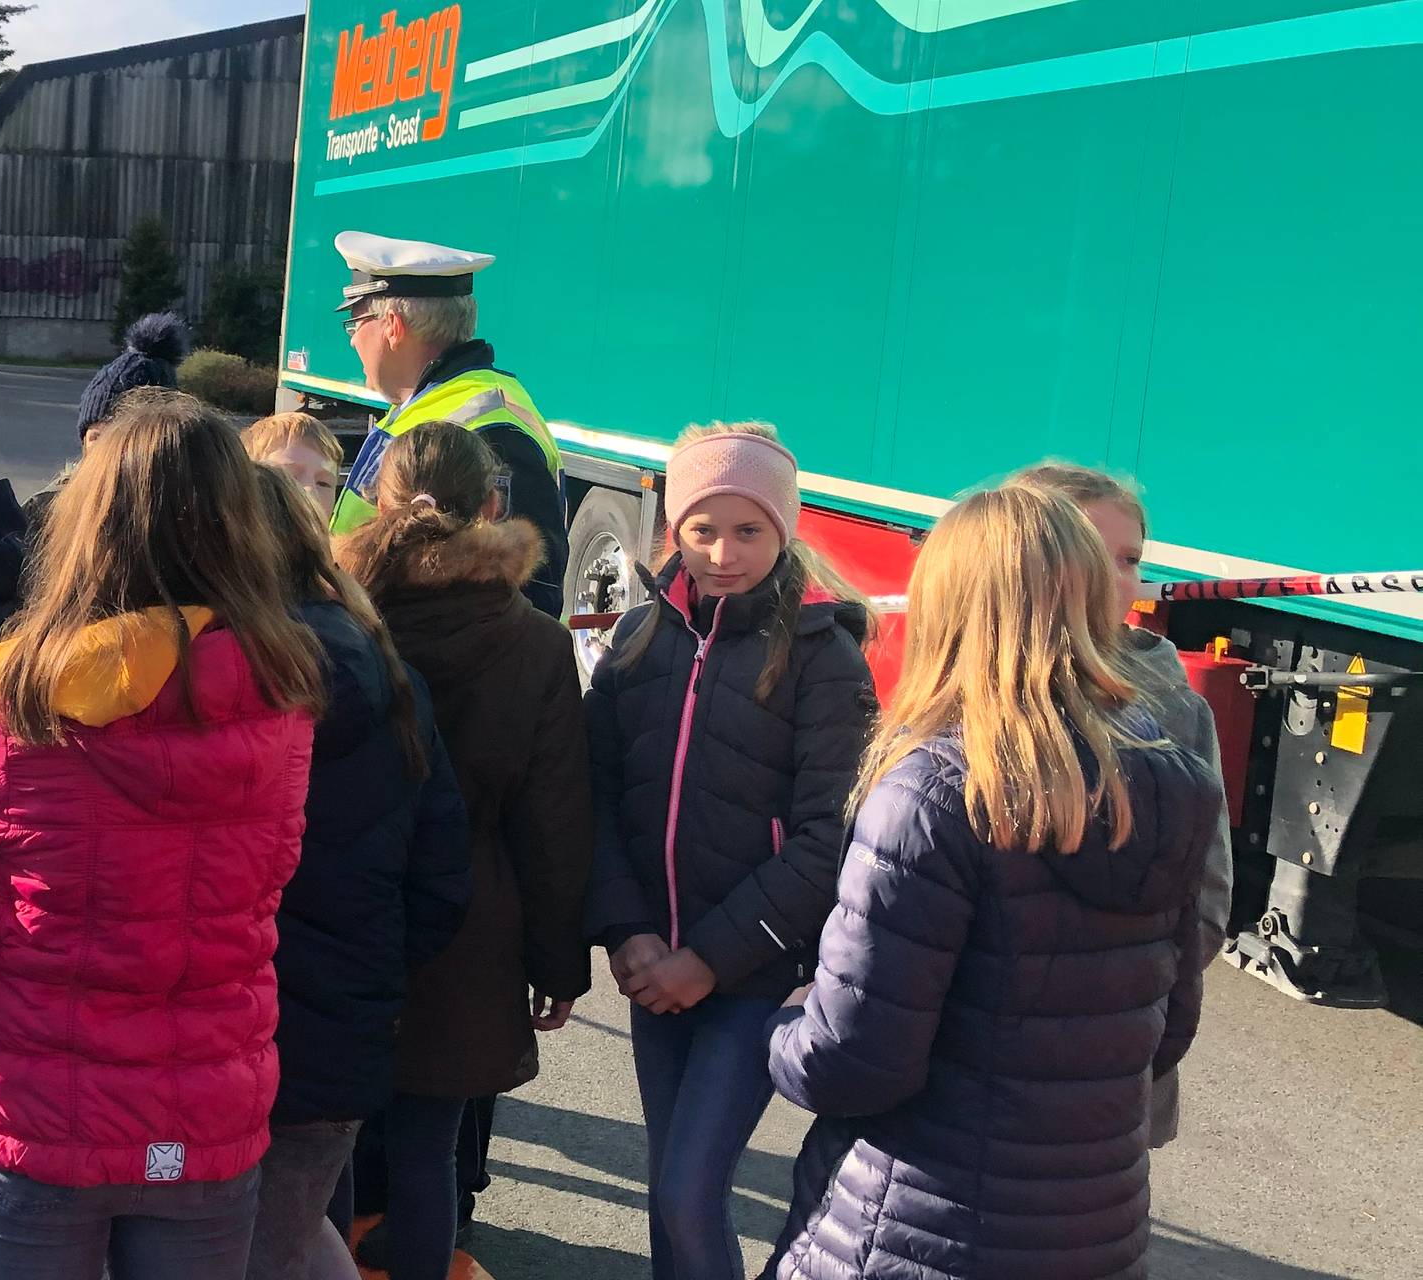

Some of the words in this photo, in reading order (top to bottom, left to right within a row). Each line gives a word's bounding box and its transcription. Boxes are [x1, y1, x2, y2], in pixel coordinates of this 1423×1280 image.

[329, 4, 460, 141] Meiberg
[326, 121, 378, 165] Transporte
[386, 109, 420, 149] Soest
